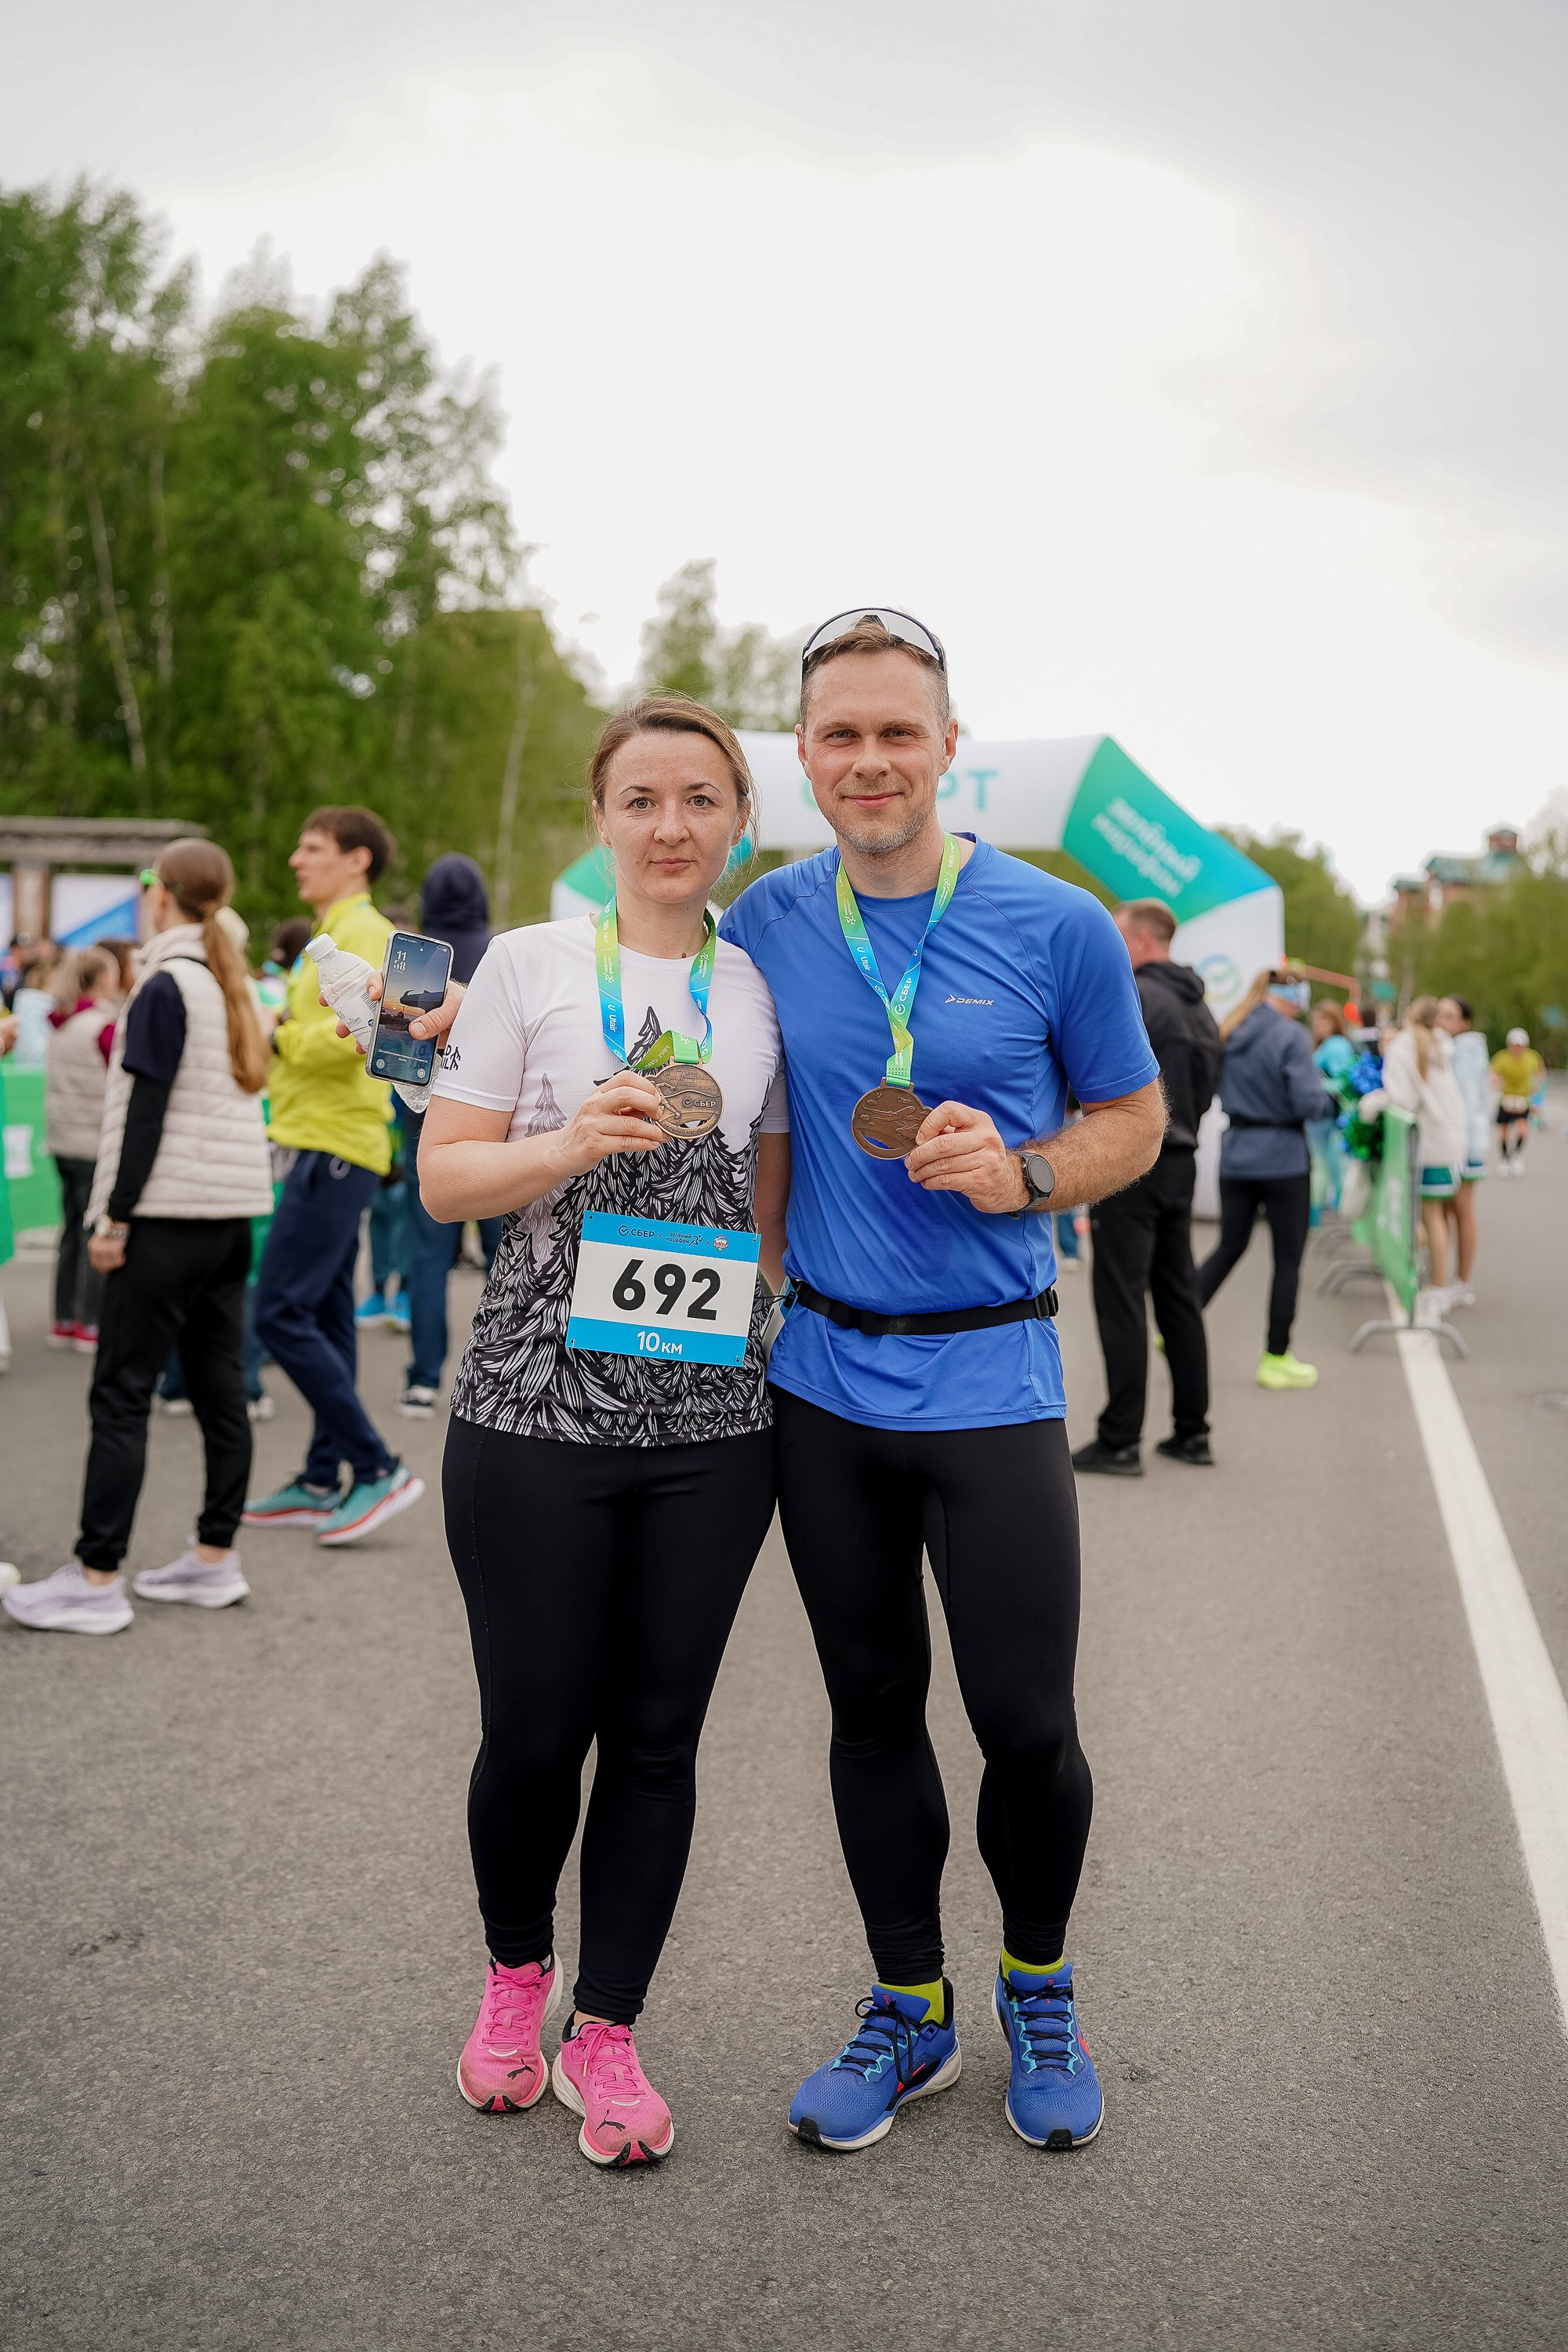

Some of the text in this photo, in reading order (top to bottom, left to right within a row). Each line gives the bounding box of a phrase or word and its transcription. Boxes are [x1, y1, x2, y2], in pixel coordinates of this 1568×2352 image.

[397, 950, 407, 961] 11
[394, 960, 406, 971] 58
[860, 956, 871, 971] Utair
[899, 977, 912, 1002] СБЕР
[956, 997, 995, 1006] DEMIX
[608, 1014, 617, 1033] Utair
[659, 1044, 671, 1058] лет
[630, 1229, 655, 1238] СБЕР
[612, 1258, 721, 1321] 692
